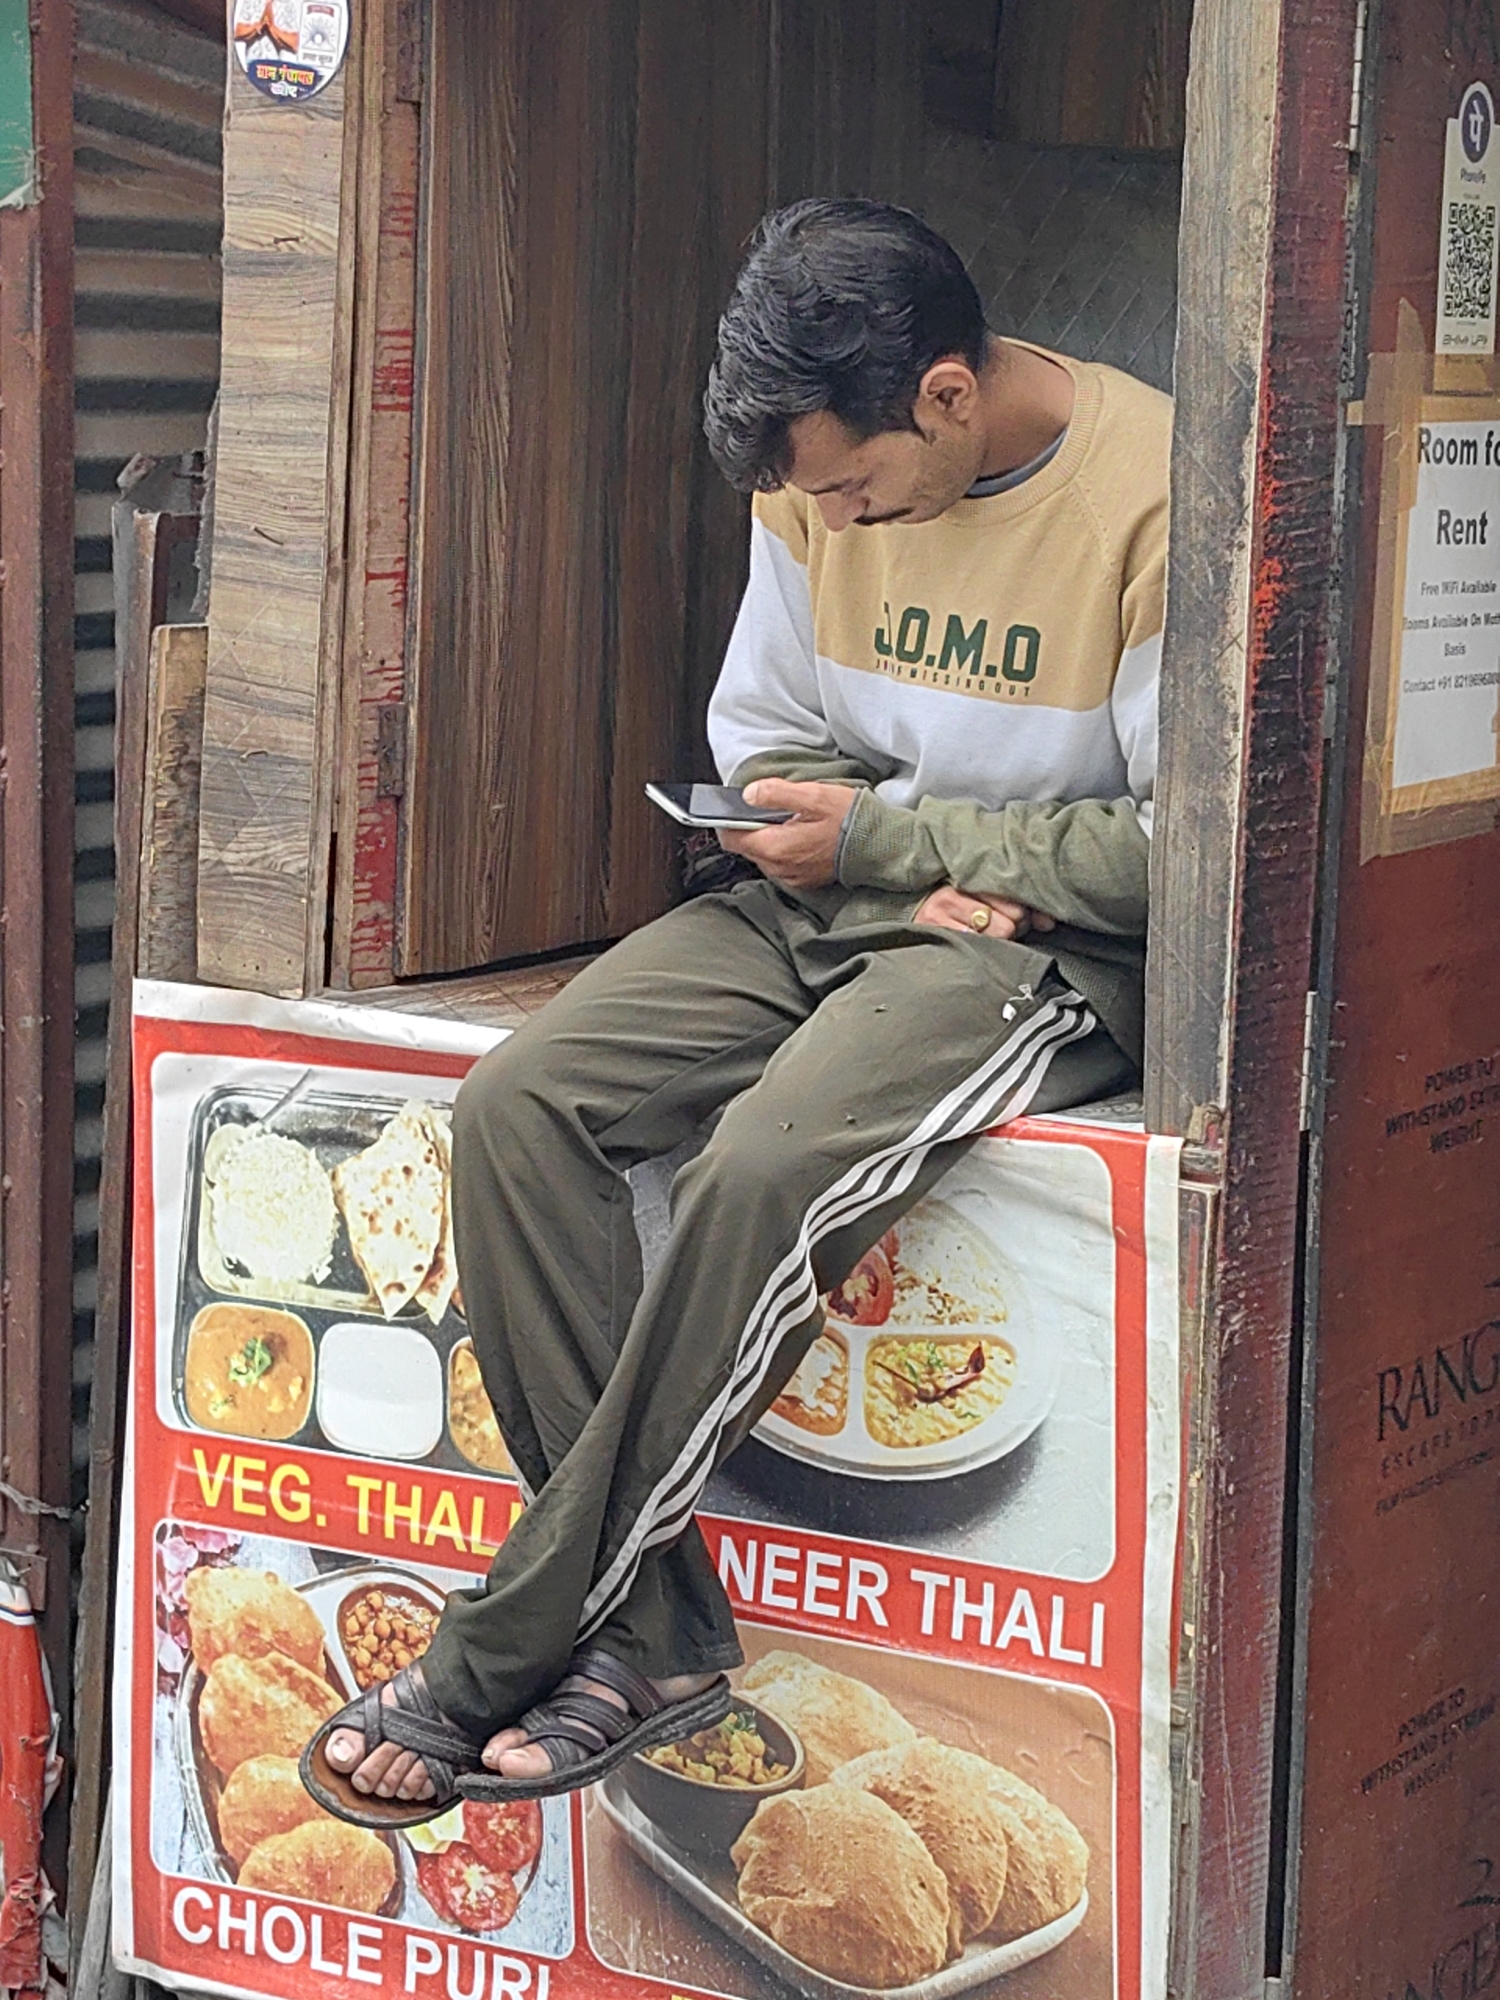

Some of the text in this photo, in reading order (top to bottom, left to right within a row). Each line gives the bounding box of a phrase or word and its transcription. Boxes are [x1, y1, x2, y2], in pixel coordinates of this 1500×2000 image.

[1418, 427, 1478, 465] Room
[1436, 509, 1488, 545] Rent
[1421, 582, 1439, 596] Free
[1460, 580, 1497, 594] Available
[1431, 614, 1467, 628] Available
[1470, 612, 1481, 626] On
[1444, 642, 1466, 657] Basis
[994, 681, 1031, 697] OUT
[1403, 679, 1435, 693] Contact
[192, 1448, 328, 1528] VEG.
[910, 1568, 1105, 1668] THALI
[172, 1886, 384, 1985] CHOLE
